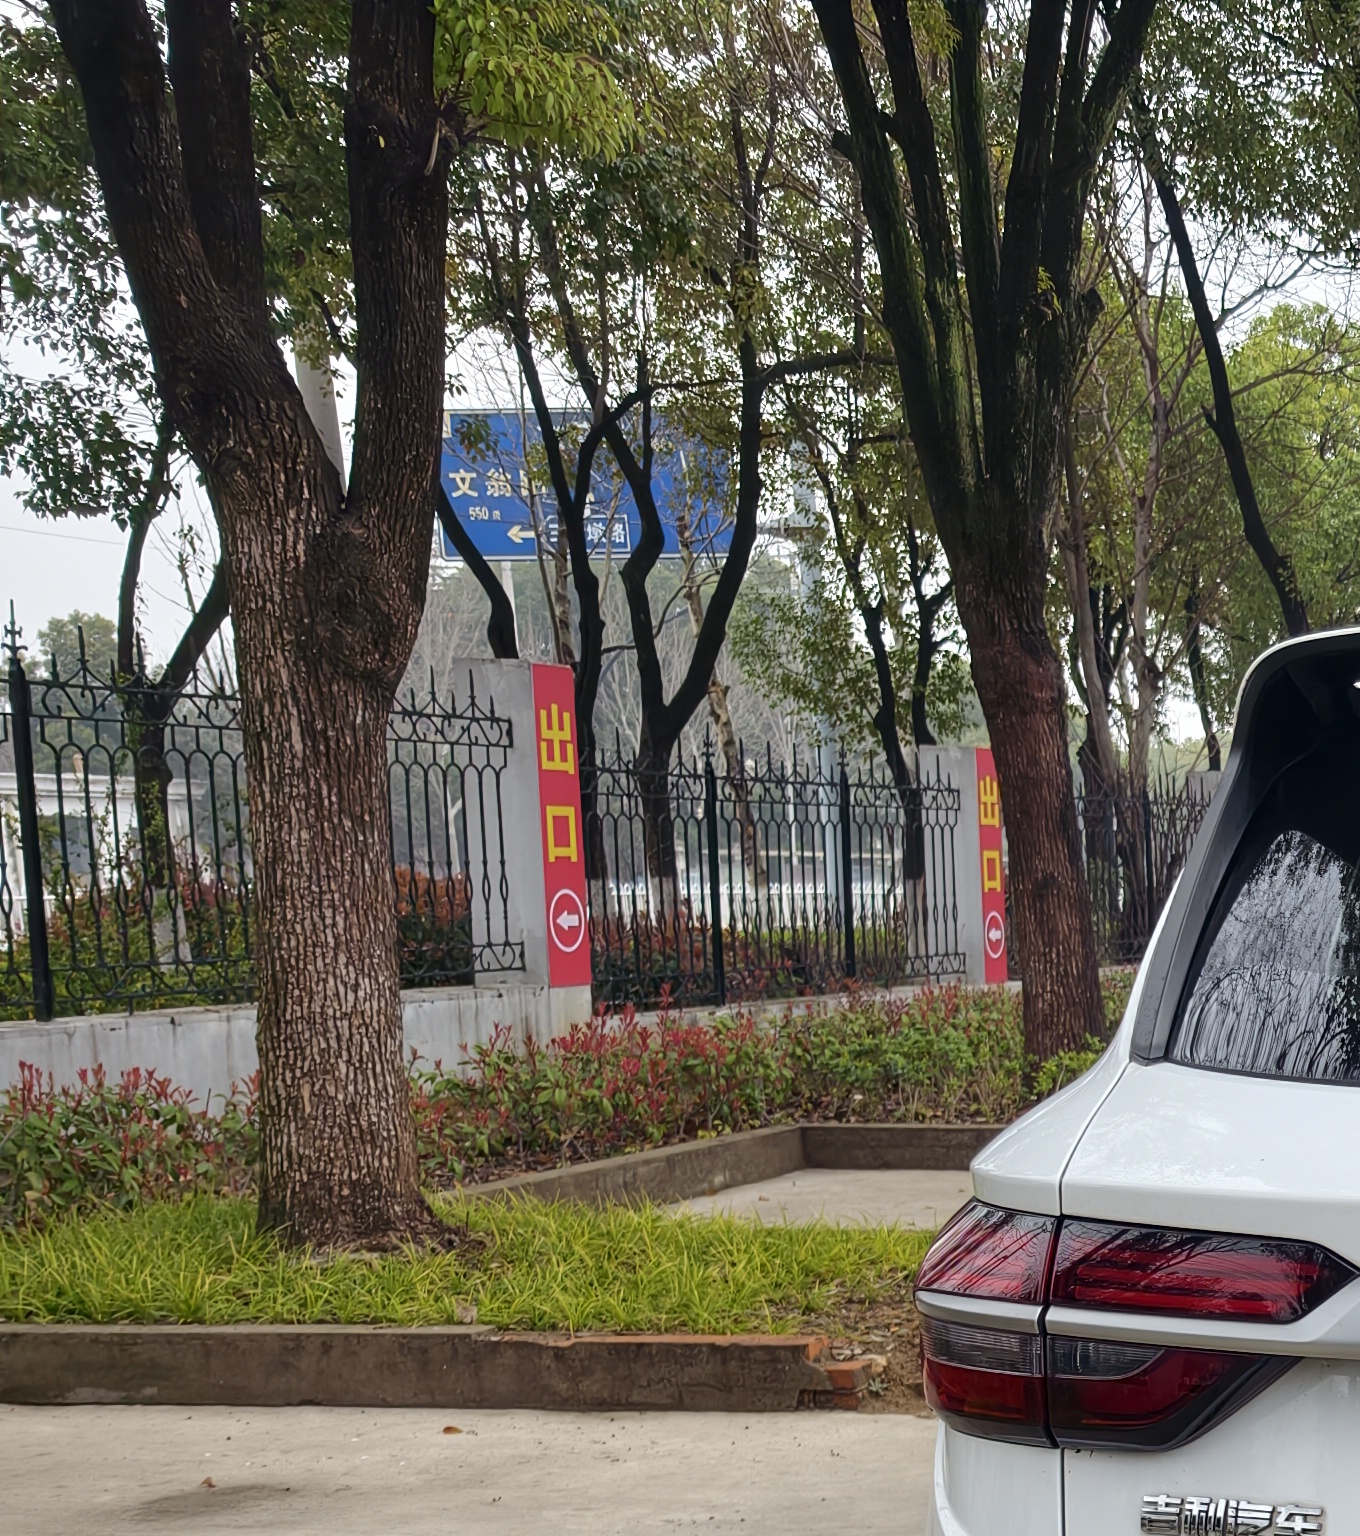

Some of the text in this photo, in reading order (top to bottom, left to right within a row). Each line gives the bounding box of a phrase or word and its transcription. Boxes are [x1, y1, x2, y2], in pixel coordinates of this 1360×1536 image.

[468, 506, 489, 521] 550
[548, 521, 626, 544] 三墩路
[539, 703, 577, 862] 出口
[979, 775, 1001, 893] 出口
